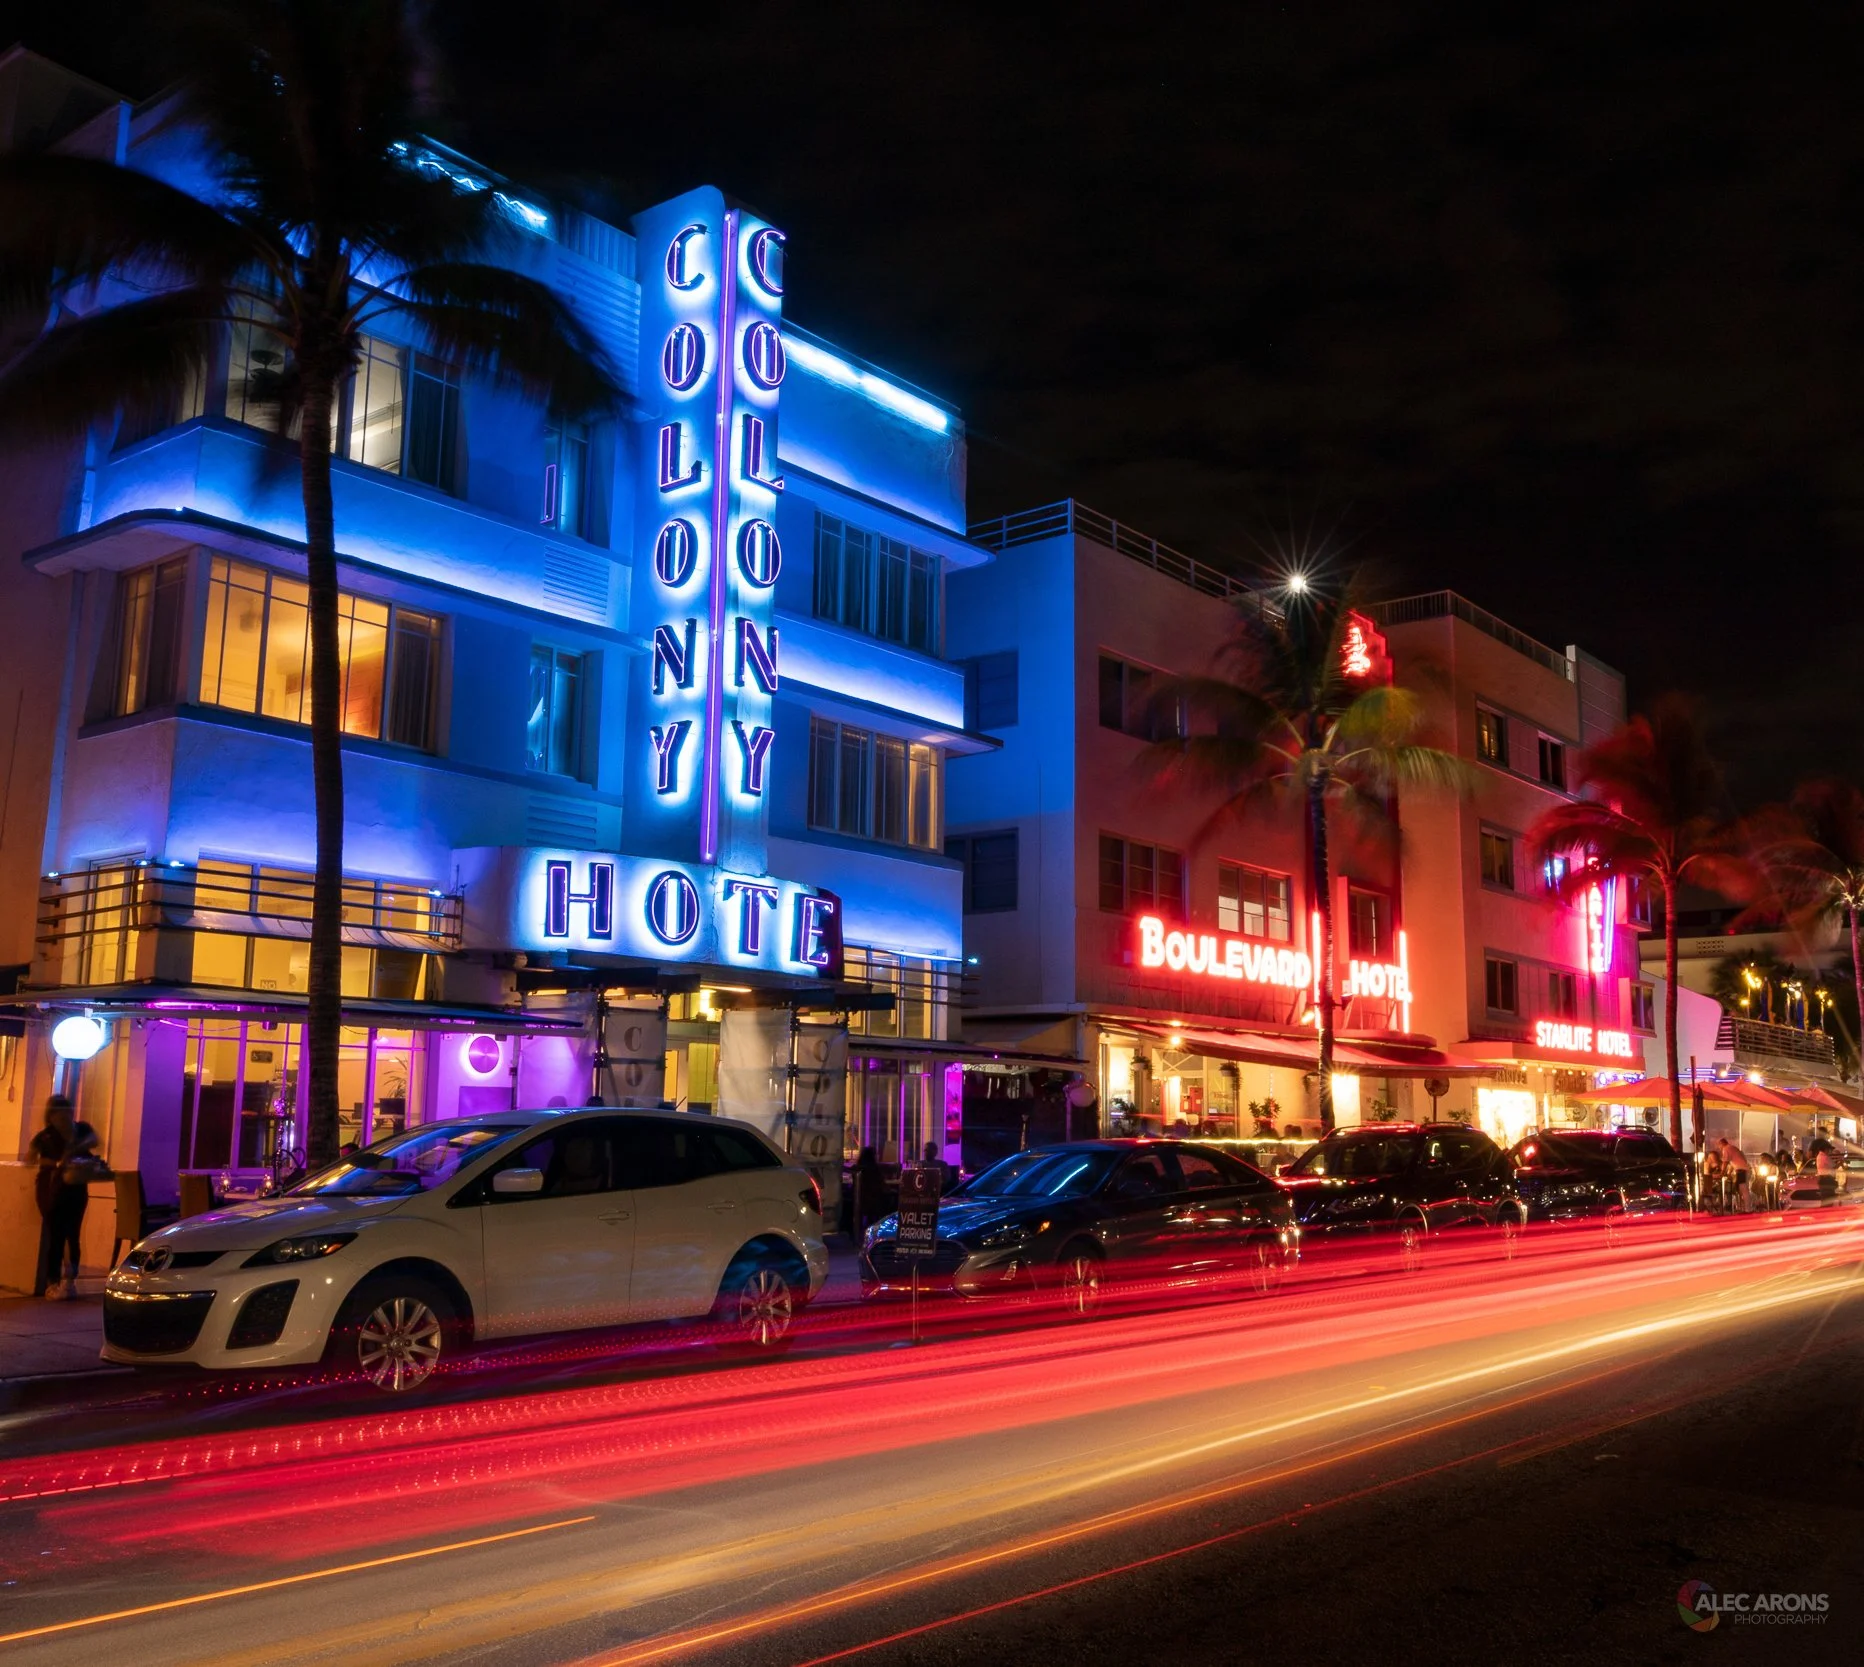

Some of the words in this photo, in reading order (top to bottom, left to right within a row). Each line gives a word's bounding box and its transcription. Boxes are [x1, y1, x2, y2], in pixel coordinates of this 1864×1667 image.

[650, 224, 708, 795] COLONY
[731, 228, 786, 796] COLONY
[1139, 916, 1313, 989] BOULEVARD
[1350, 960, 1412, 1003] HOTEL
[1536, 1021, 1592, 1052] STARLITE
[1598, 1030, 1633, 1056] HOTEL
[900, 1212, 935, 1225] VALET
[900, 1228, 932, 1240] PARKING
